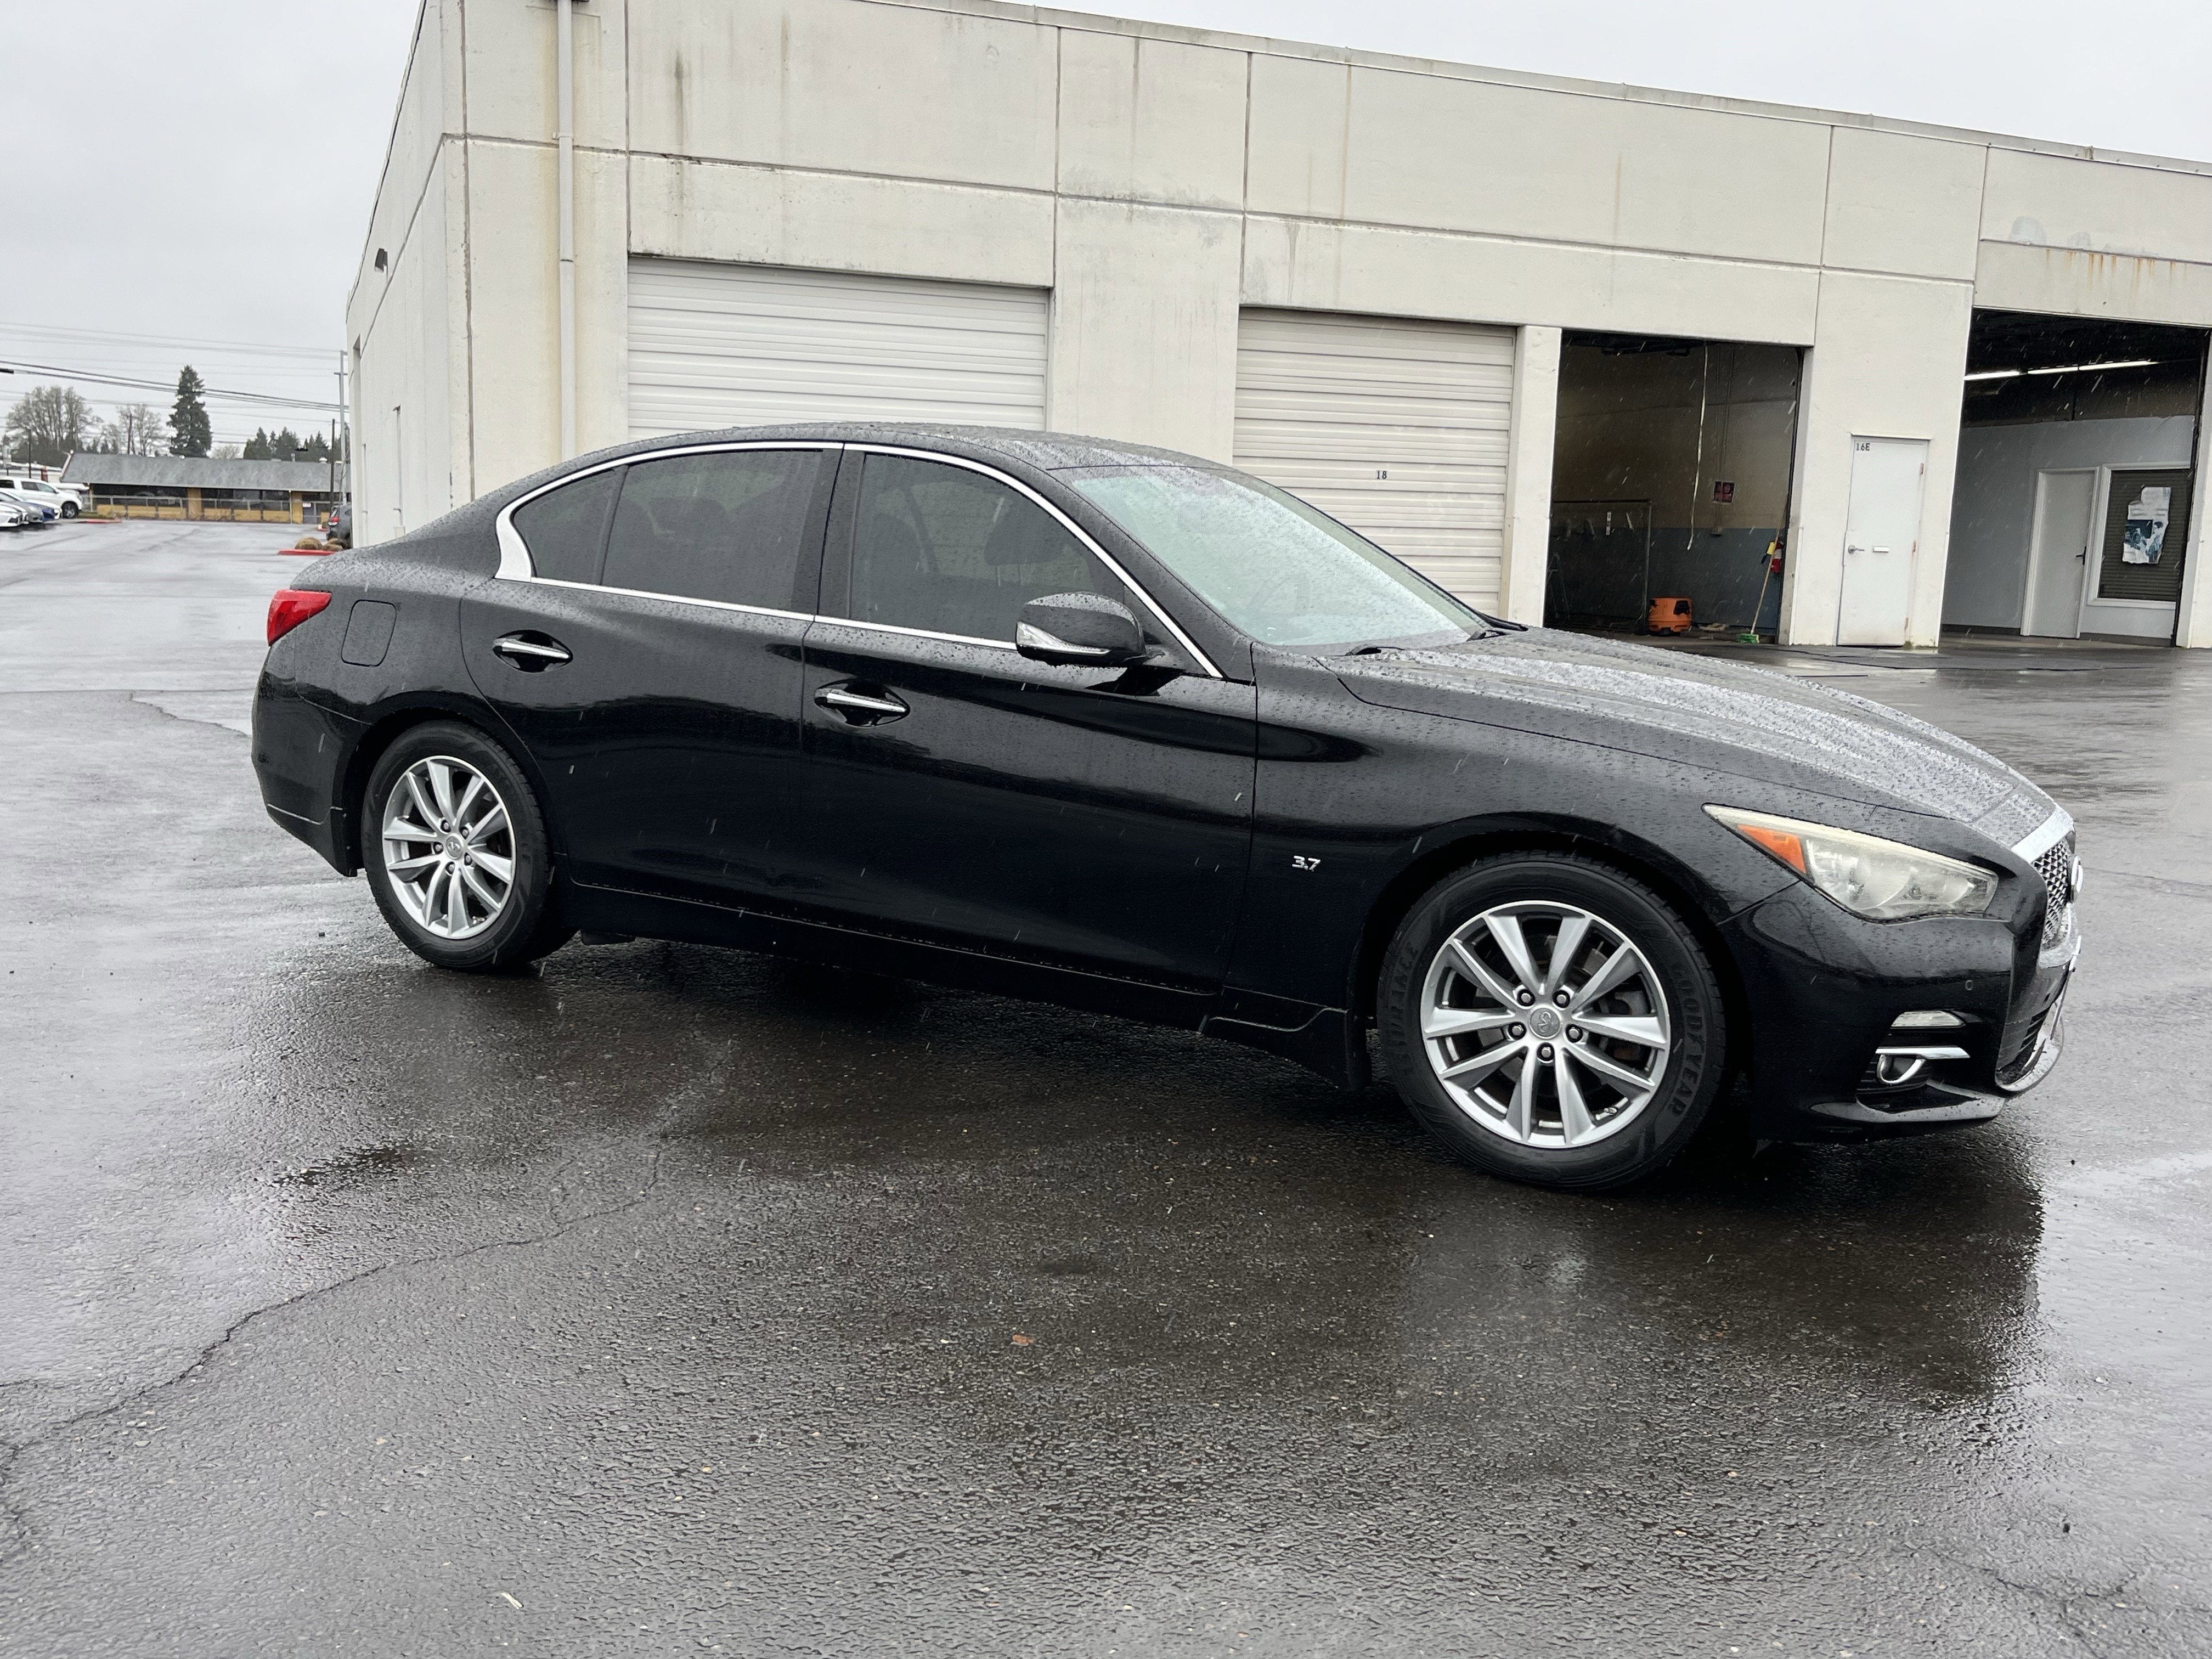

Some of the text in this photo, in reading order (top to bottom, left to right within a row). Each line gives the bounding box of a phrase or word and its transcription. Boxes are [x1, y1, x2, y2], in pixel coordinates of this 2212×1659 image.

[1857, 443, 1870, 451] 16E
[1377, 471, 1387, 479] 18
[1668, 962, 1704, 1115] GOODYEAR
